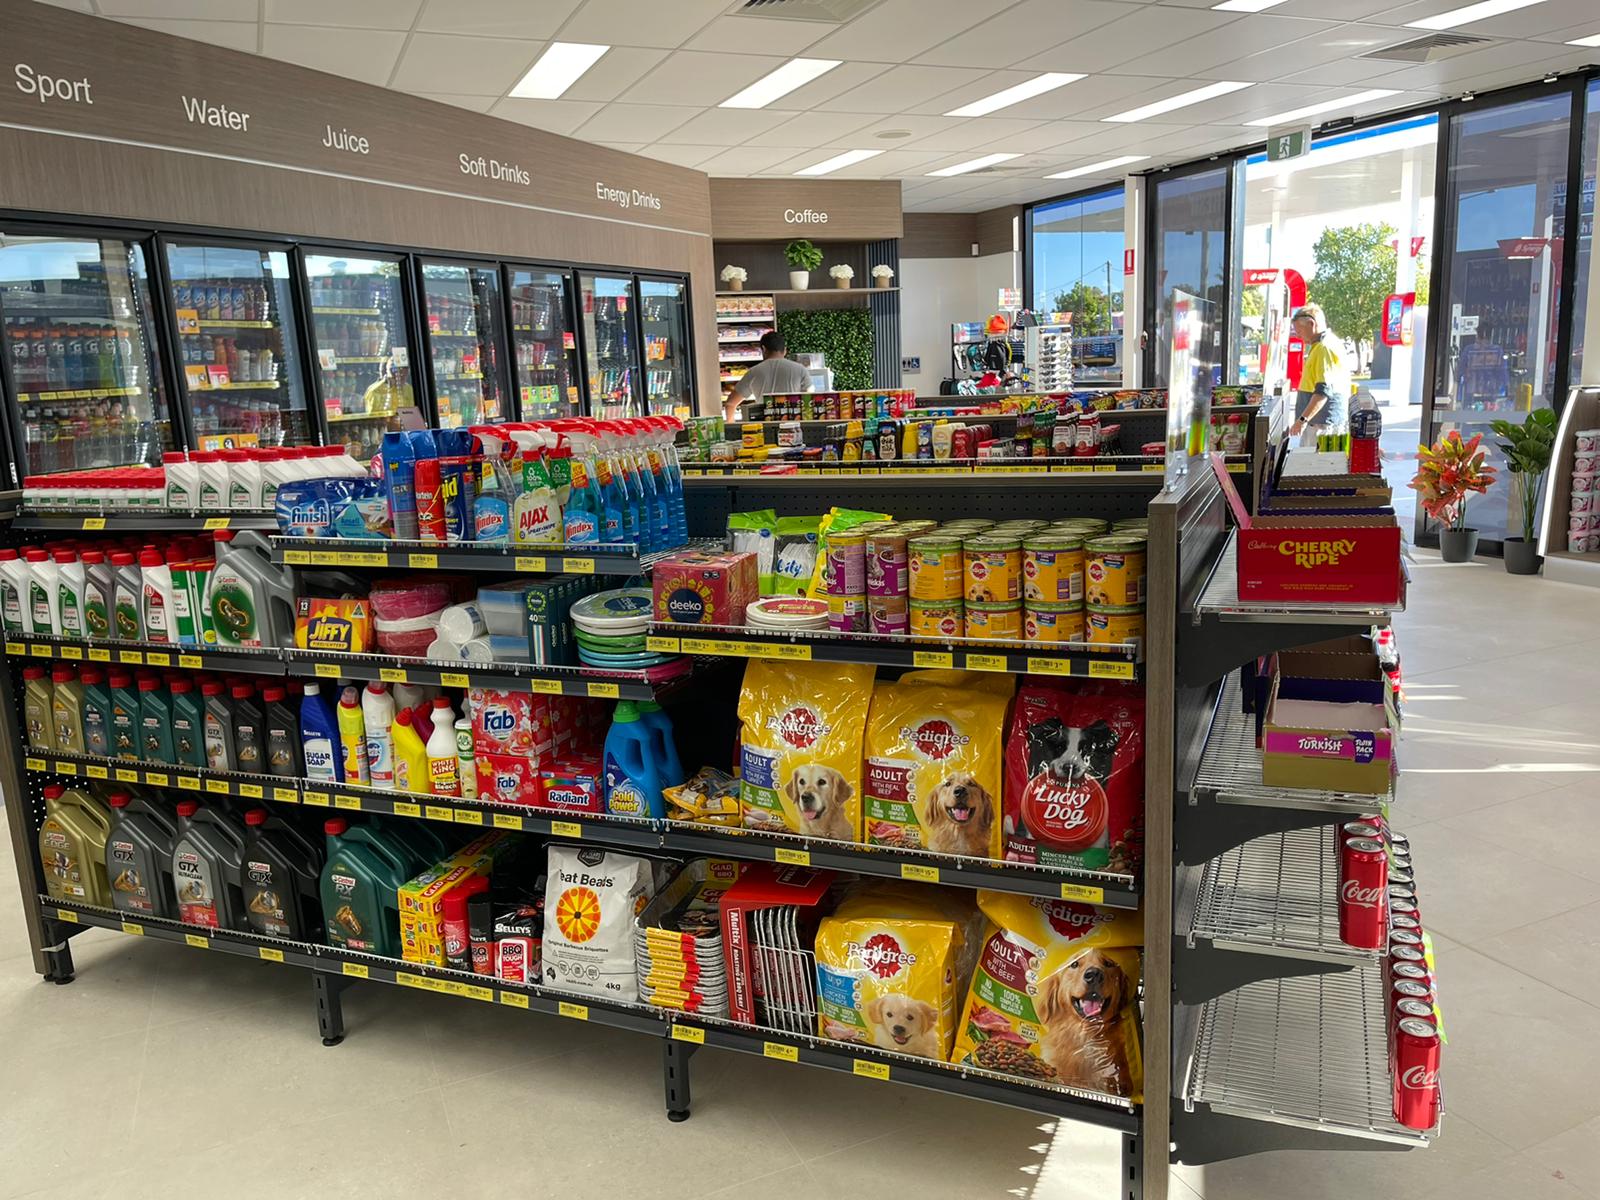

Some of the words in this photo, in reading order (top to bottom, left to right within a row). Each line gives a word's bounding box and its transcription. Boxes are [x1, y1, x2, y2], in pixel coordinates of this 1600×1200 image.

[14, 63, 93, 104] Sport
[182, 96, 250, 131] Water
[322, 125, 370, 154] Juice
[459, 153, 488, 178] Soft
[490, 160, 530, 186] Drinks
[596, 182, 630, 208] Energy
[632, 189, 661, 210] Drinks
[784, 209, 828, 224] Coffee
[292, 507, 327, 523] finish
[520, 505, 549, 530] AJAX
[1279, 539, 1356, 555] CHERRY
[776, 558, 803, 577] Lily
[1296, 553, 1339, 569] RIPE
[301, 602, 308, 611] 13
[670, 600, 702, 610] deeko
[529, 614, 538, 622] 40
[484, 711, 515, 730] Fab
[208, 728, 220, 736] GTX
[900, 728, 970, 747] Pedigree
[306, 752, 330, 760] SUGAR
[744, 753, 767, 767] ADULT
[870, 768, 902, 782] ADULT
[497, 777, 516, 788] Fab
[872, 781, 885, 789] WITH
[885, 783, 900, 791] REAL
[550, 791, 589, 805] Radiant
[613, 789, 634, 801] Cold
[878, 787, 892, 795] BEEF
[1035, 783, 1091, 809] Lucky
[609, 799, 639, 812] Power
[1043, 803, 1089, 829] Dog
[44, 839, 70, 849] EDGE
[1008, 841, 1036, 854] ADULT
[113, 850, 134, 861] GTX
[1041, 851, 1067, 859] MINCED
[178, 862, 198, 873] GTX
[710, 863, 732, 871] GLAD
[178, 872, 202, 880] ULTRACLEAN
[248, 869, 272, 883] GTX
[338, 877, 354, 885] Castrol
[560, 868, 578, 885] eat
[335, 883, 353, 895] RX
[424, 881, 444, 897] GLAD
[1030, 896, 1115, 927] Pedigree
[494, 923, 532, 934] SELLEYS
[729, 912, 741, 944] Multix
[502, 944, 522, 955] BBQ
[989, 939, 1021, 963] ADULT
[502, 953, 522, 962] TOUGH
[733, 949, 742, 978] ROASTING
[992, 957, 1007, 970] WITH
[997, 968, 1015, 982] BEEF
[605, 982, 621, 991] 4kg
[1000, 996, 1020, 1009] COMPLETE
[1003, 989, 1022, 1004] 100%
[1021, 1029, 1037, 1038] MEAT
